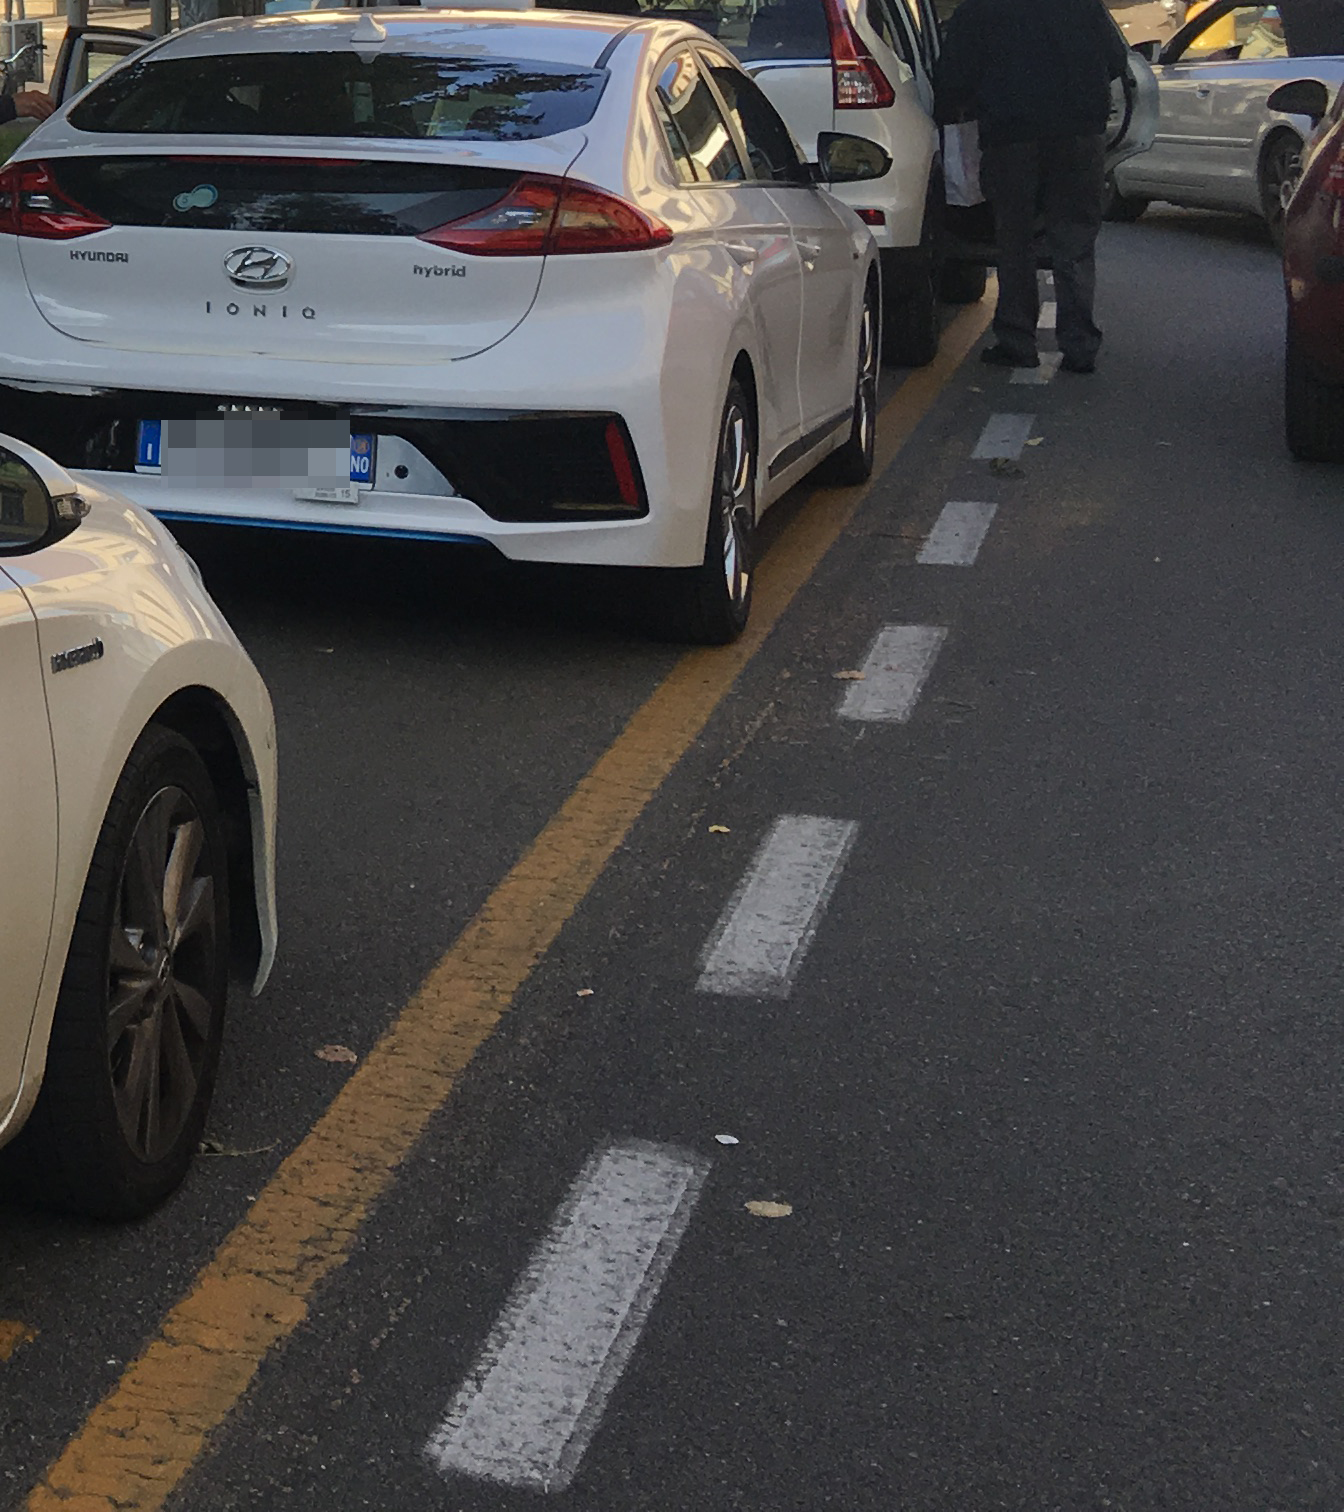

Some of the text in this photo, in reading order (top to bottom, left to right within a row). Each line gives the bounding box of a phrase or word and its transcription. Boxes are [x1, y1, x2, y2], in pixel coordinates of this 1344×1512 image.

[70, 250, 129, 264] HYUNDAI
[413, 264, 467, 278] hybrid
[206, 300, 316, 320] IONIQ
